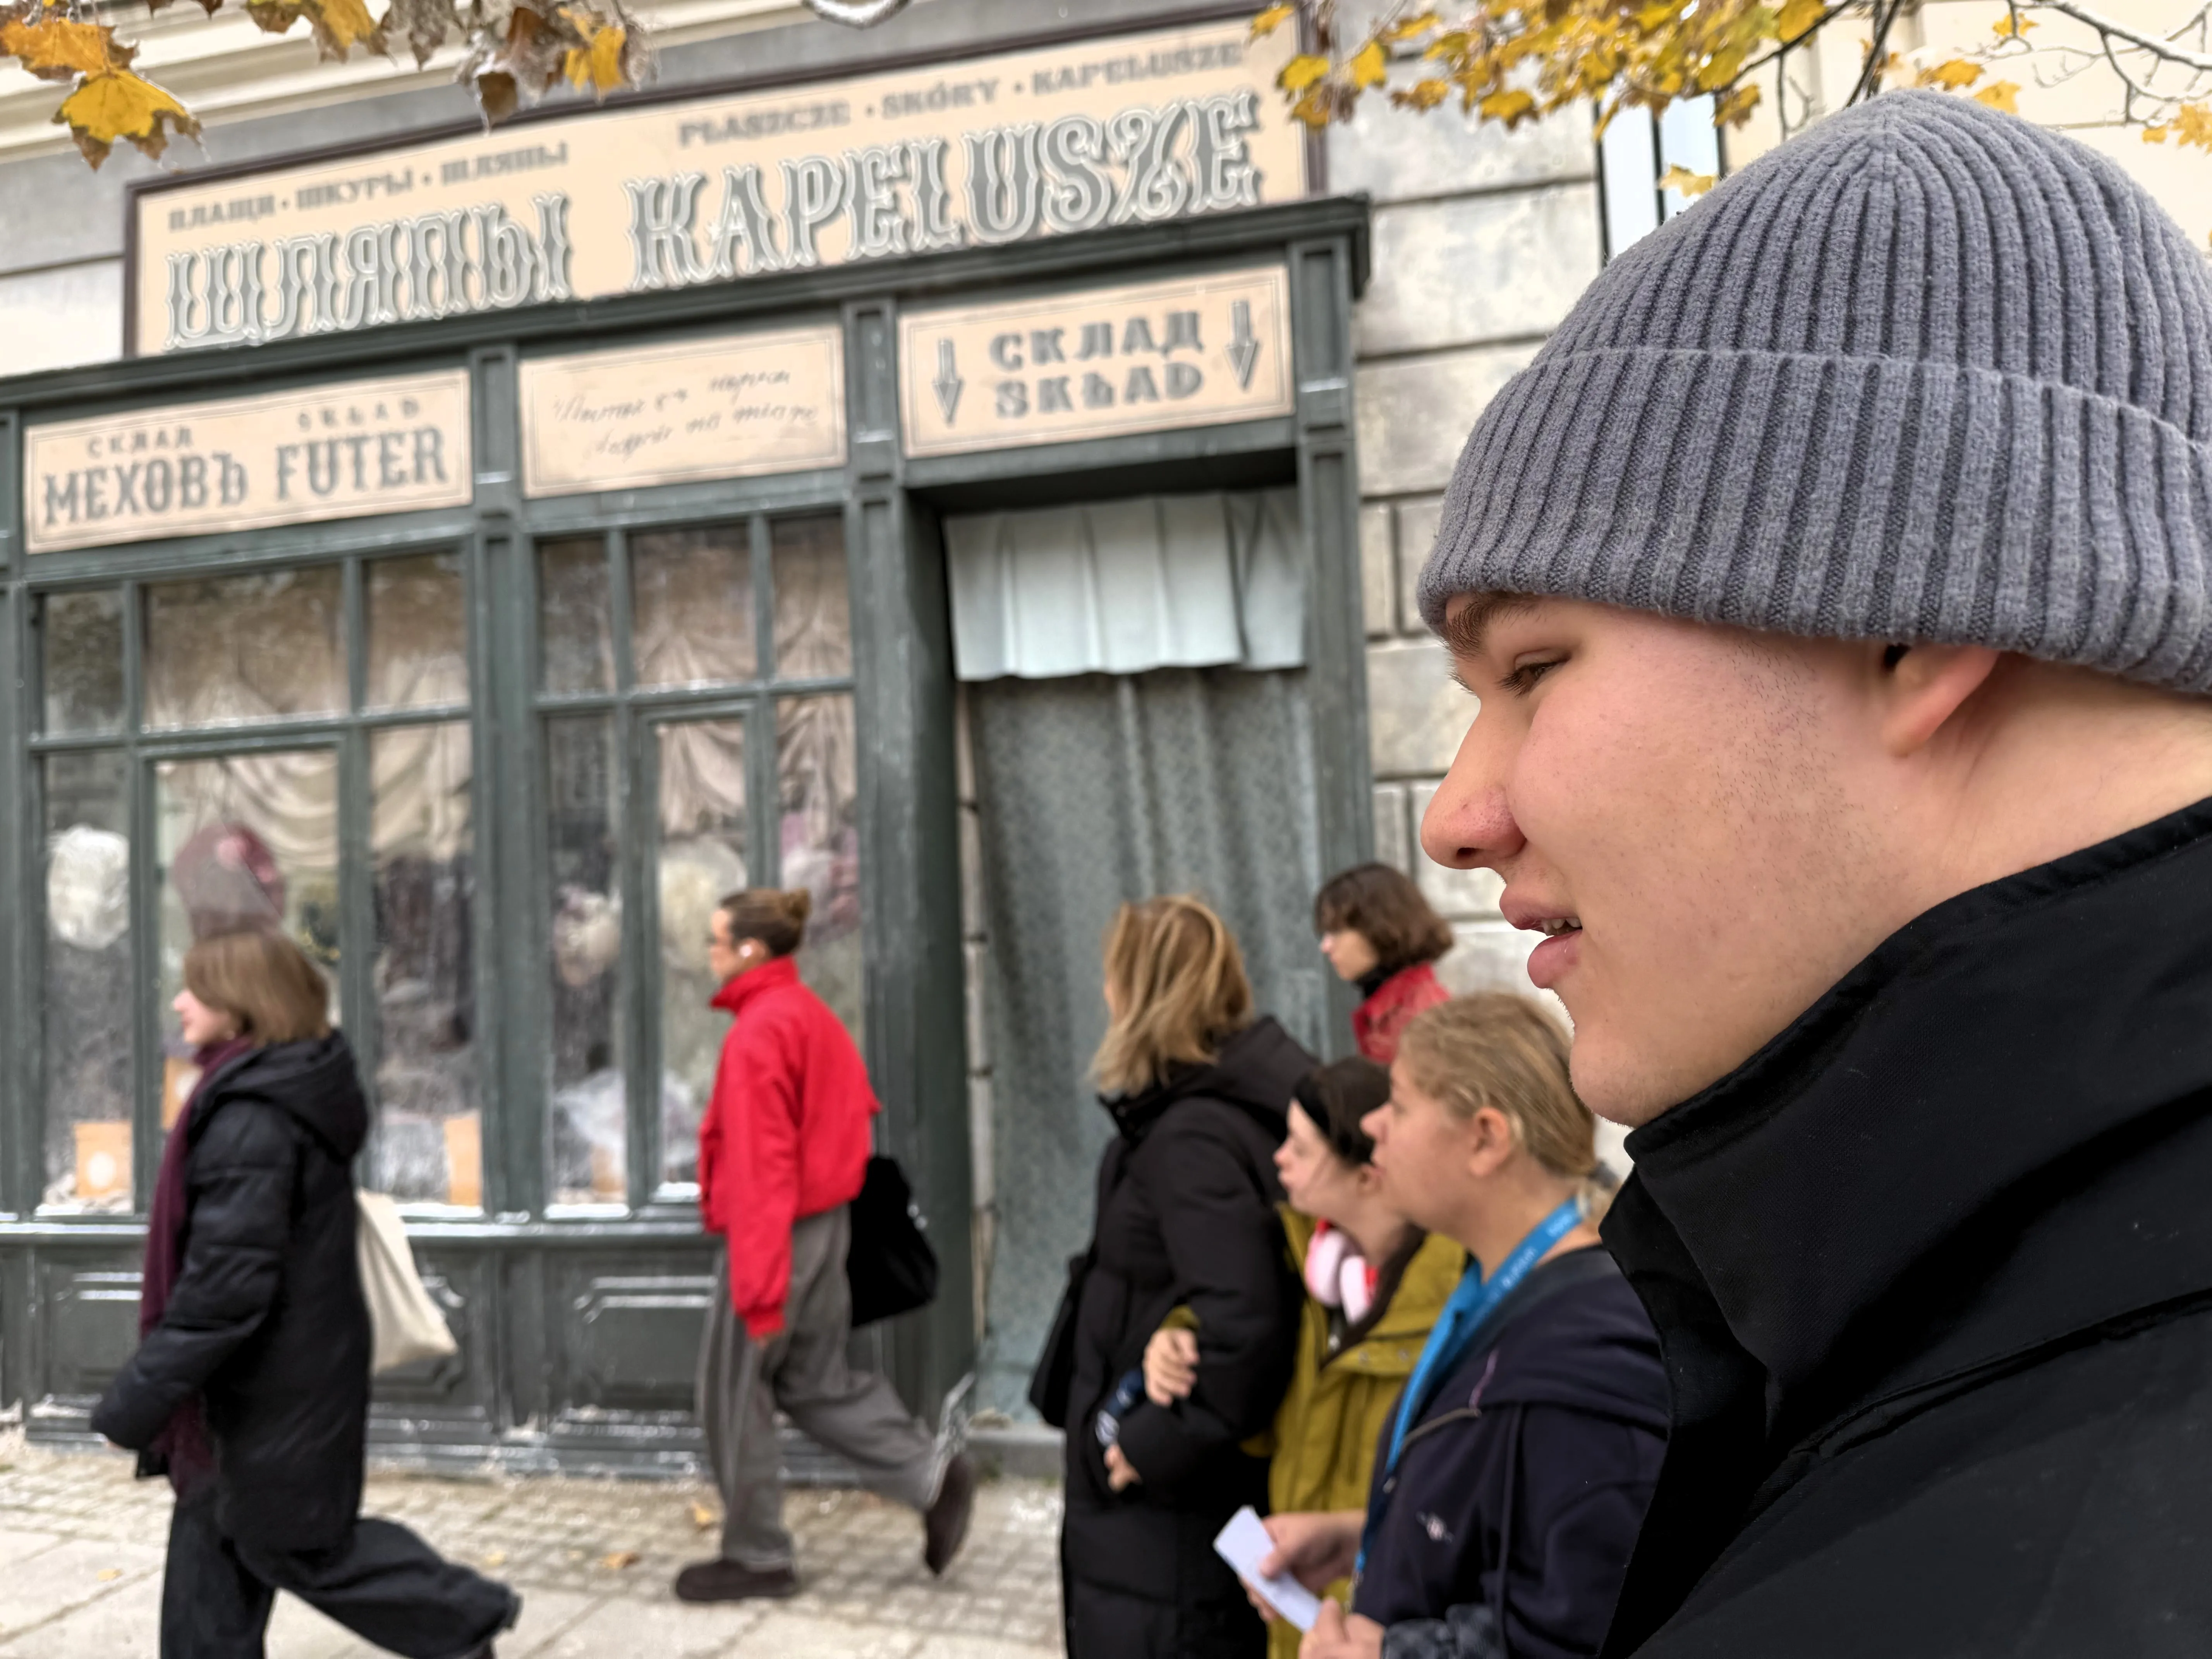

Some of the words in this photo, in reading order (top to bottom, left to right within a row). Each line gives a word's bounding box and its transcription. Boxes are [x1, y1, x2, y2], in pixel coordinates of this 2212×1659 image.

[623, 88, 1262, 292] KAPELUSZE
[164, 190, 572, 351] ШЛЯПЫ
[990, 310, 1204, 372] СКЛАД
[994, 360, 1204, 419] SKŁAD
[43, 452, 249, 526] МЕХОВЪ
[276, 425, 448, 501] FUTER
